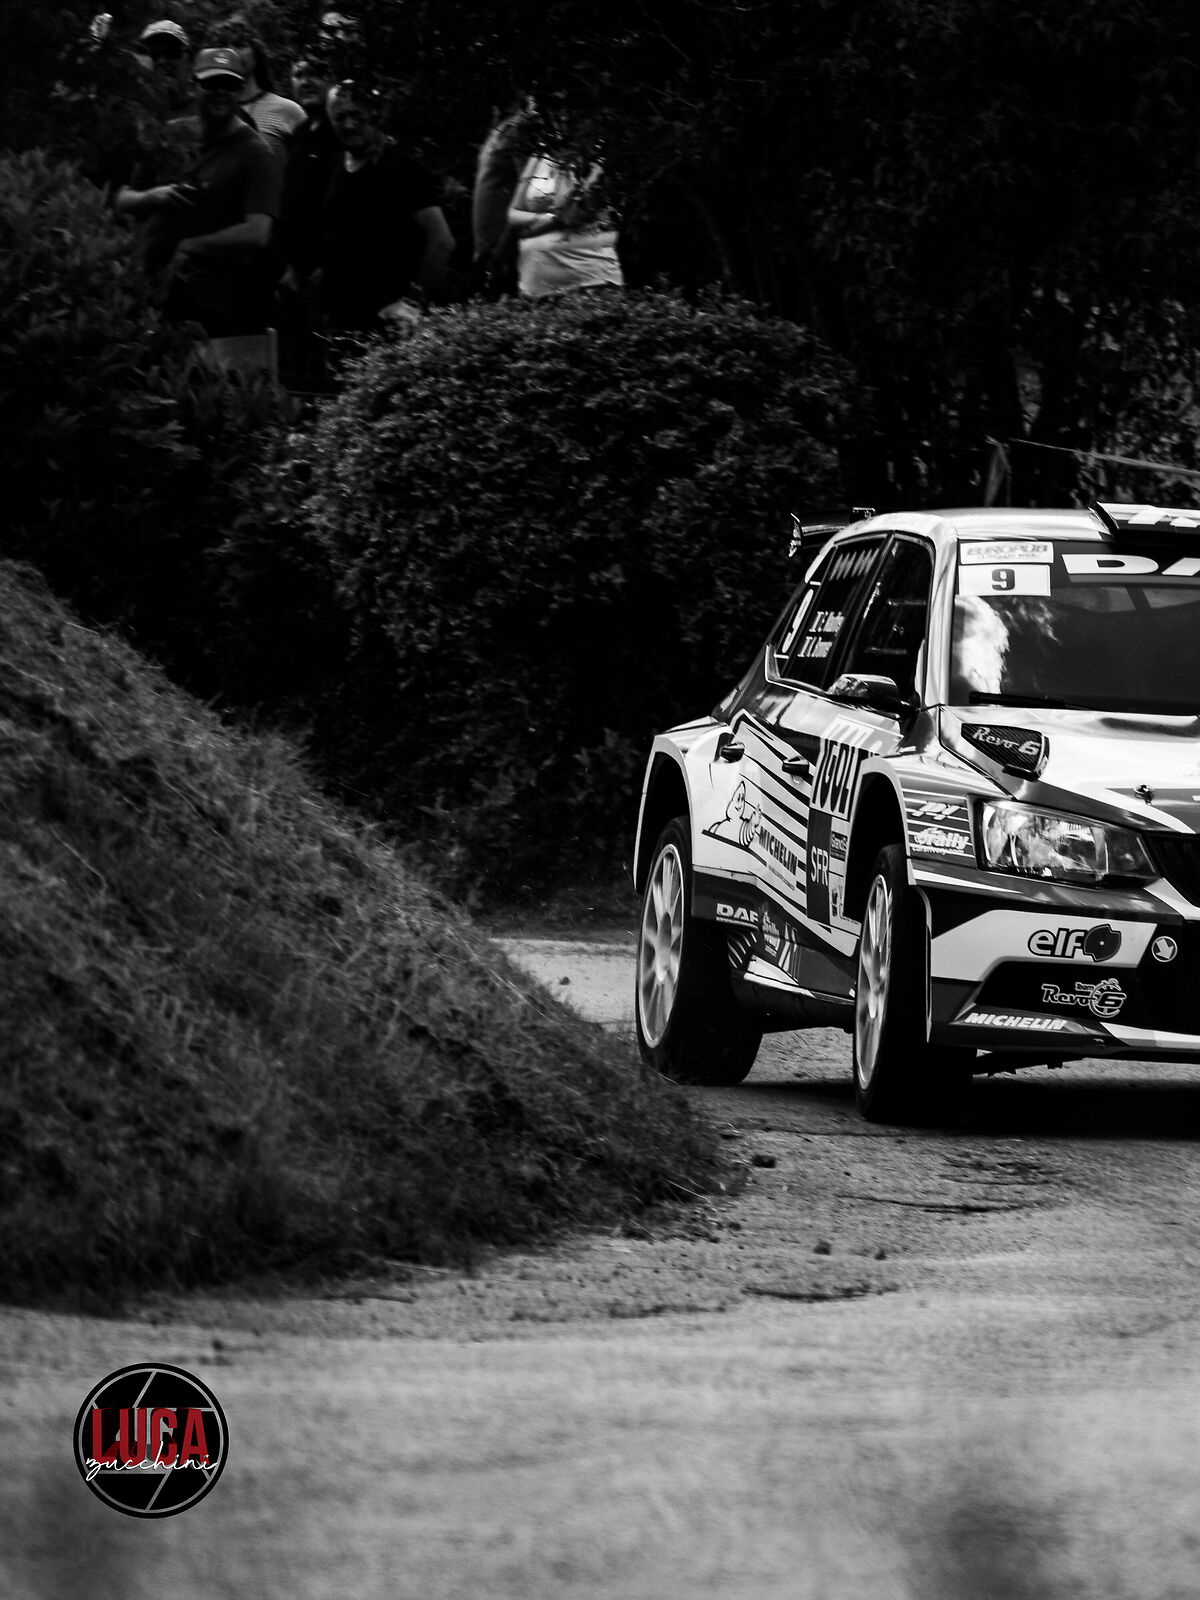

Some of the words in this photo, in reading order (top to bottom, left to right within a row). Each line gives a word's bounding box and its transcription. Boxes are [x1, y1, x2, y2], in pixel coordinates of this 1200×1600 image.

[991, 568, 1015, 591] 9
[759, 826, 797, 876] MICHELIN
[811, 845, 829, 887] SFR
[717, 903, 759, 923] DAF
[1028, 928, 1088, 958] elf
[964, 1013, 1067, 1030] MICHELIN
